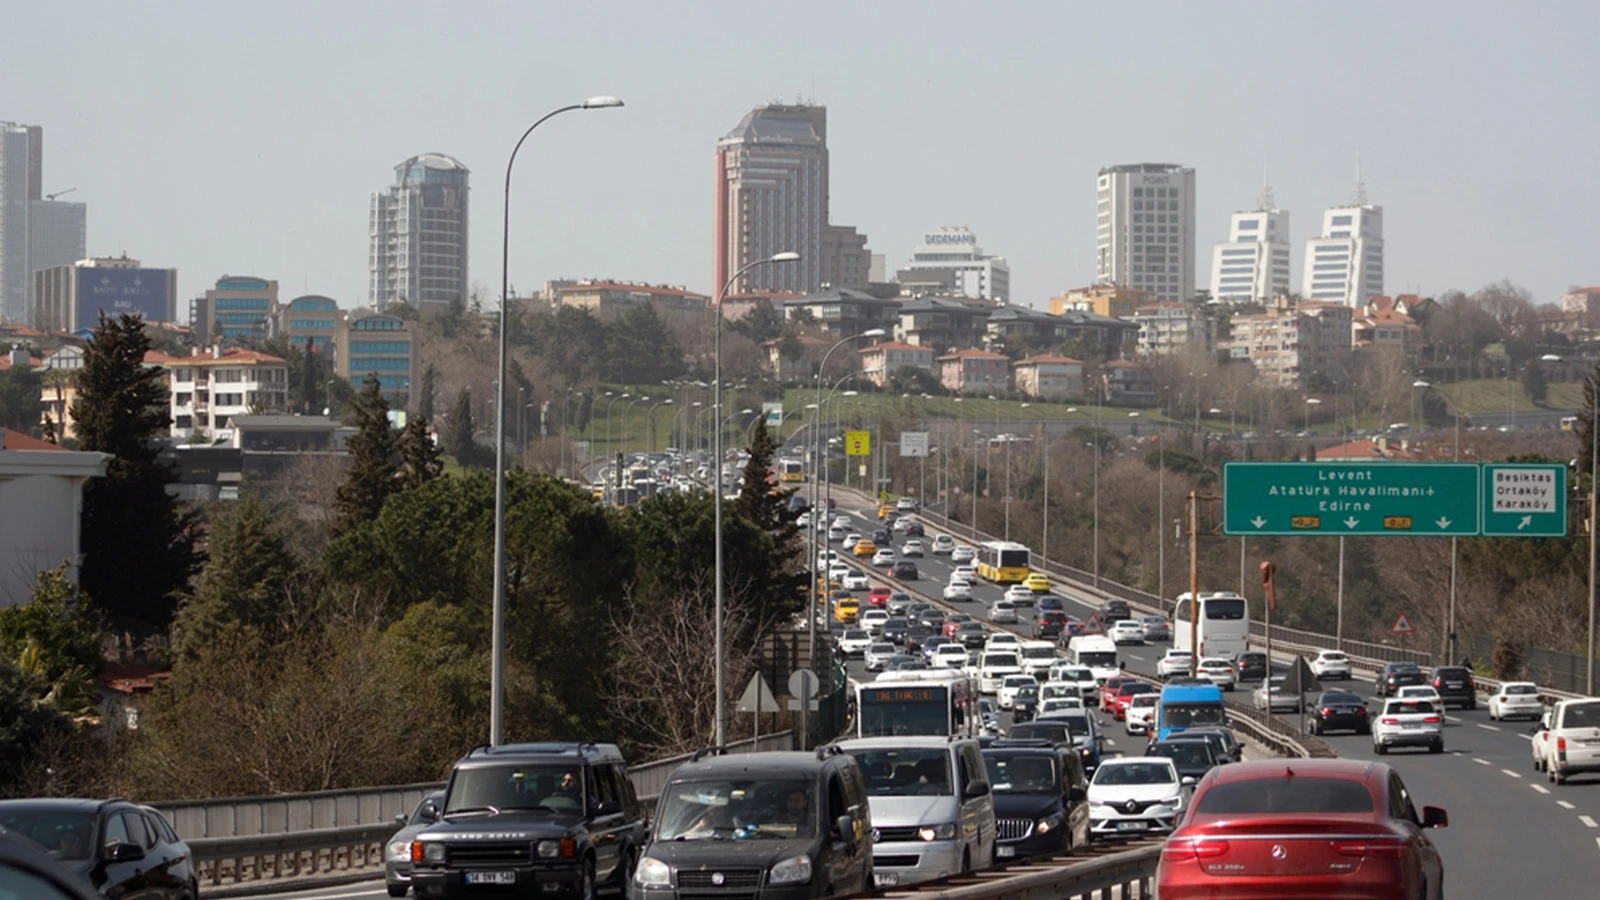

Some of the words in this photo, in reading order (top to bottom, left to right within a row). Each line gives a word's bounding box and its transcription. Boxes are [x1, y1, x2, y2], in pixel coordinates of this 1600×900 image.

[1142, 175, 1169, 185] POINT
[924, 233, 970, 246] DEDEMAN
[1318, 470, 1373, 481] Levent
[1269, 484, 1331, 497] Atatürk
[1338, 484, 1425, 497] Havalimanı
[1496, 485, 1548, 498] Ortaköy
[1319, 500, 1372, 512] Edirne
[1496, 499, 1549, 511] Karaköy
